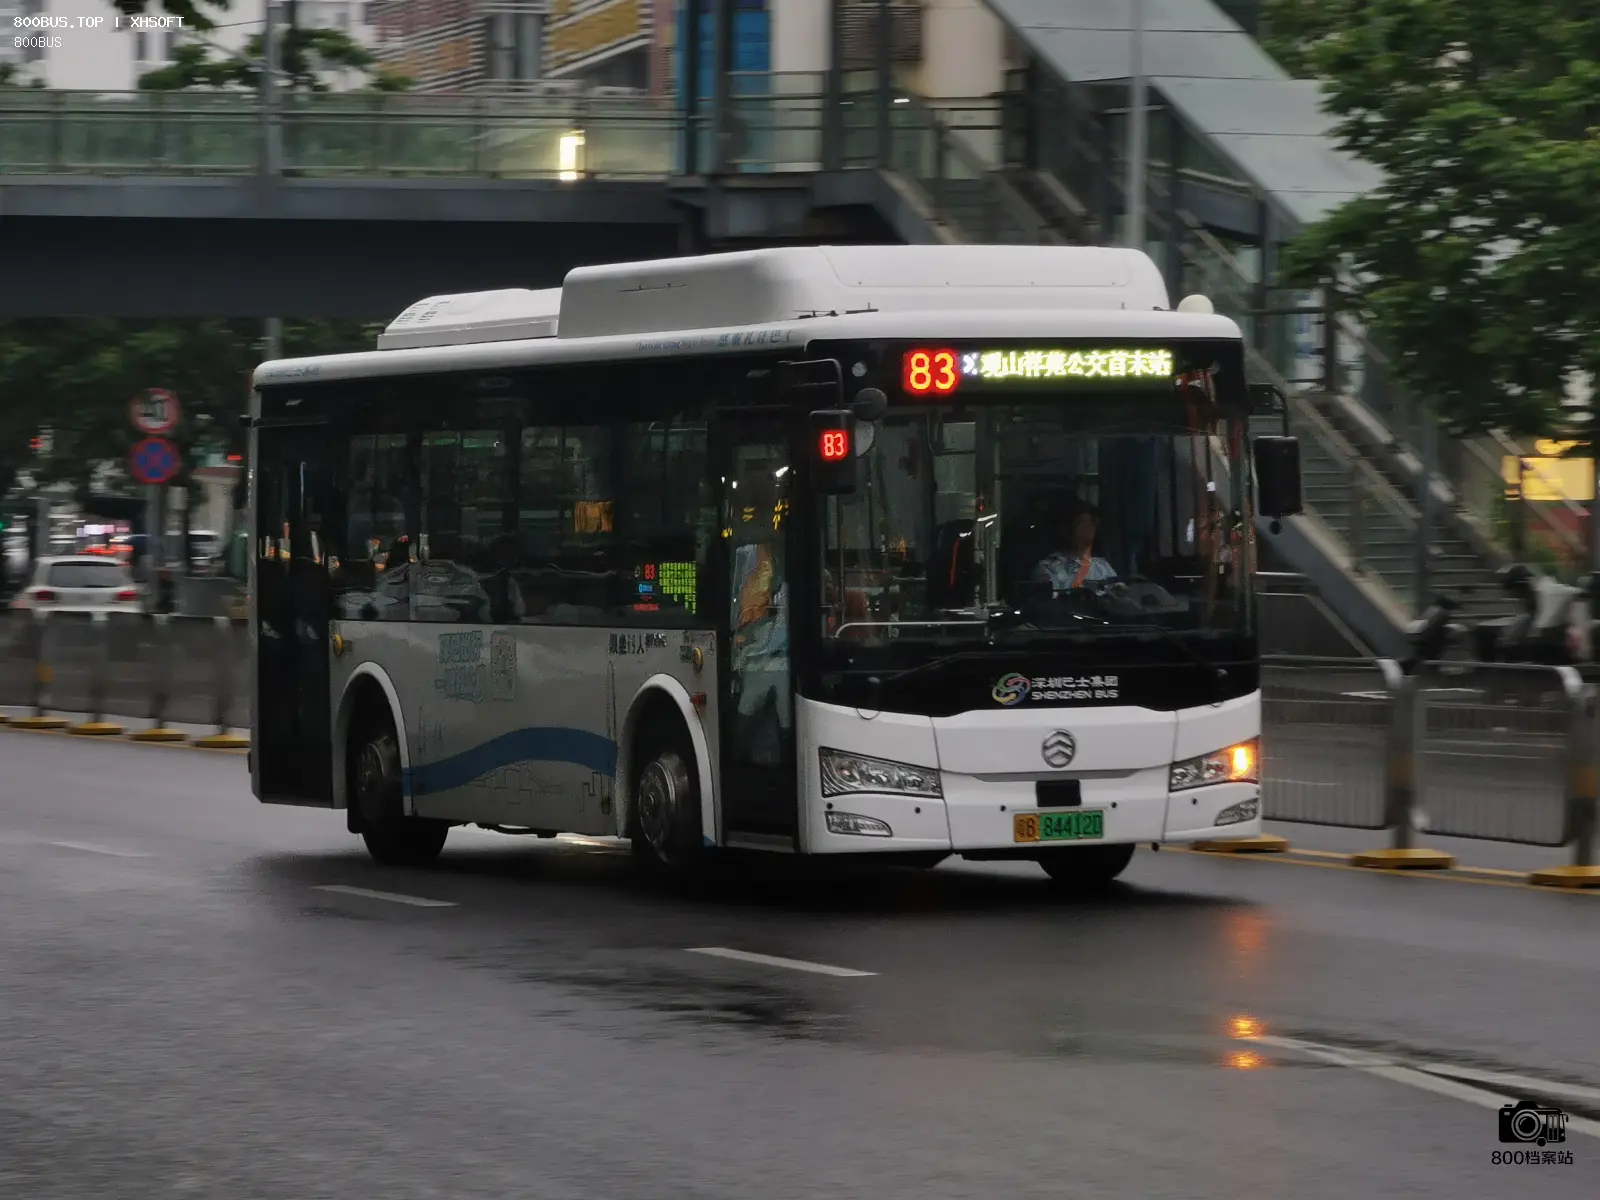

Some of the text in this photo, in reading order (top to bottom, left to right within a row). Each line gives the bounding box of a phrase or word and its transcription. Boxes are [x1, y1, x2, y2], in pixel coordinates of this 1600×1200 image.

[908, 352, 956, 390] 83
[823, 433, 845, 457] 83
[1031, 689, 1119, 700] SHENZHEN BUS
